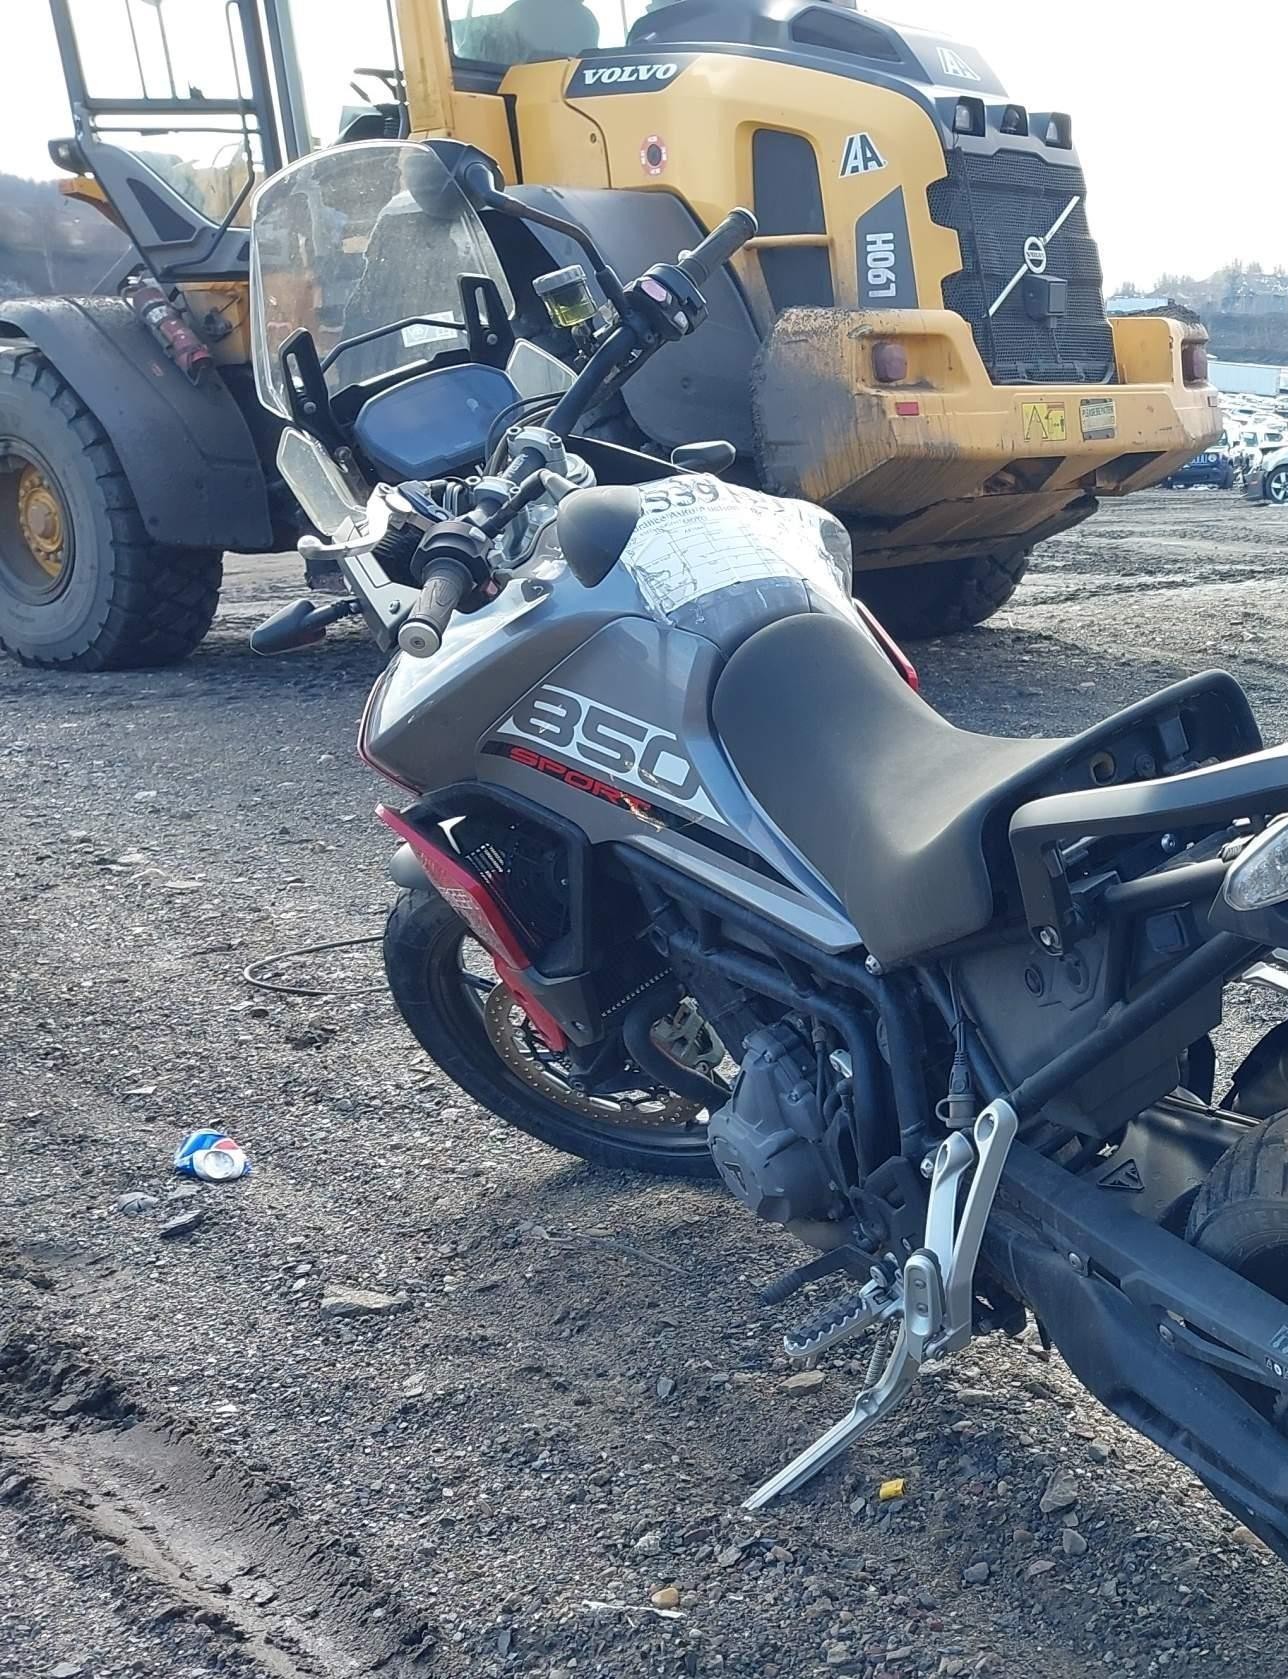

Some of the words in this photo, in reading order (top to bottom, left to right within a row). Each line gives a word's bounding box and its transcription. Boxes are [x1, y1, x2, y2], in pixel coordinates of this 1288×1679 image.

[583, 63, 678, 85] VOLVO
[865, 232, 896, 298] L90H
[510, 685, 702, 803] 850
